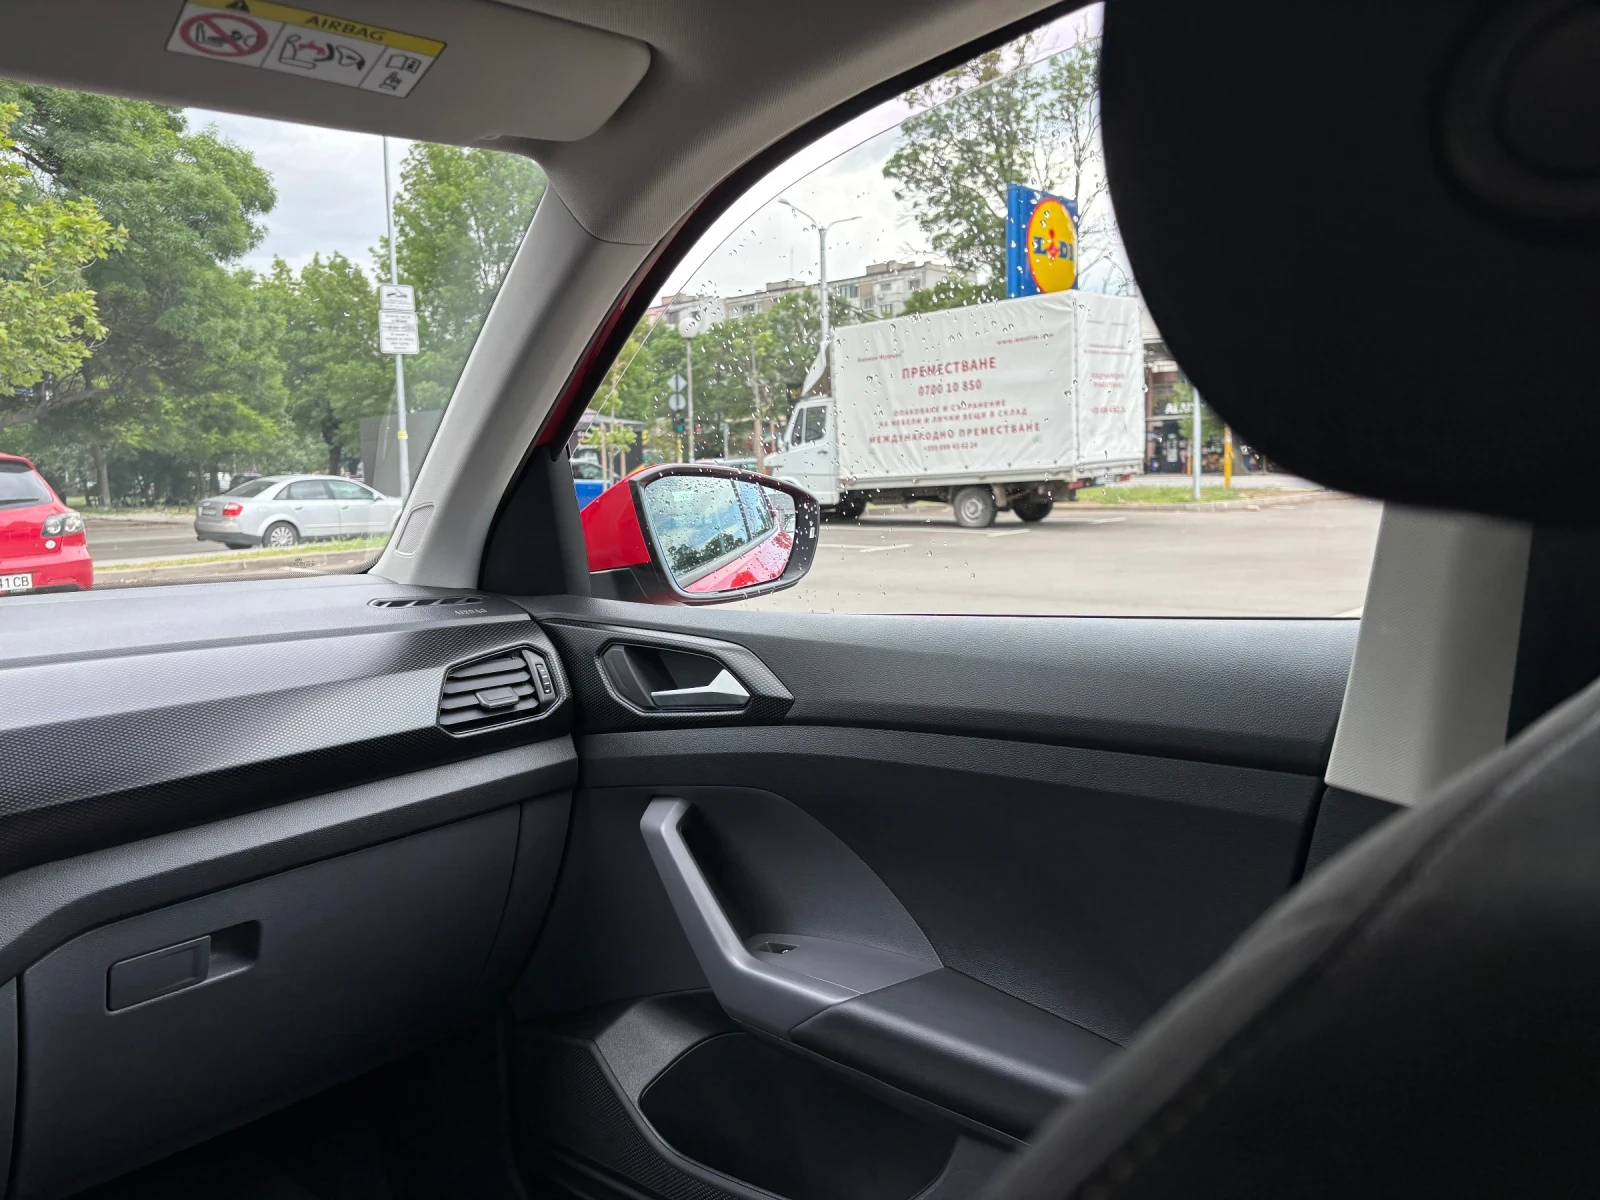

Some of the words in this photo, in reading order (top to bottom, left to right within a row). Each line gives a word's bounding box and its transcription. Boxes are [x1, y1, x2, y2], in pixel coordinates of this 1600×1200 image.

[304, 15, 386, 41] AIRBAG
[902, 356, 997, 380] ПРЕМЕСТВАНЕ
[918, 384, 943, 396] 0700
[946, 382, 959, 393] 10
[962, 379, 982, 392] 850
[950, 399, 1006, 412] СЪРАНЕНИЕ
[998, 408, 1028, 417] СКЛАД
[868, 429, 954, 445] МЕЖДУНАРОДНО
[958, 422, 1041, 438] ПРЕМЕСТВАНЕ
